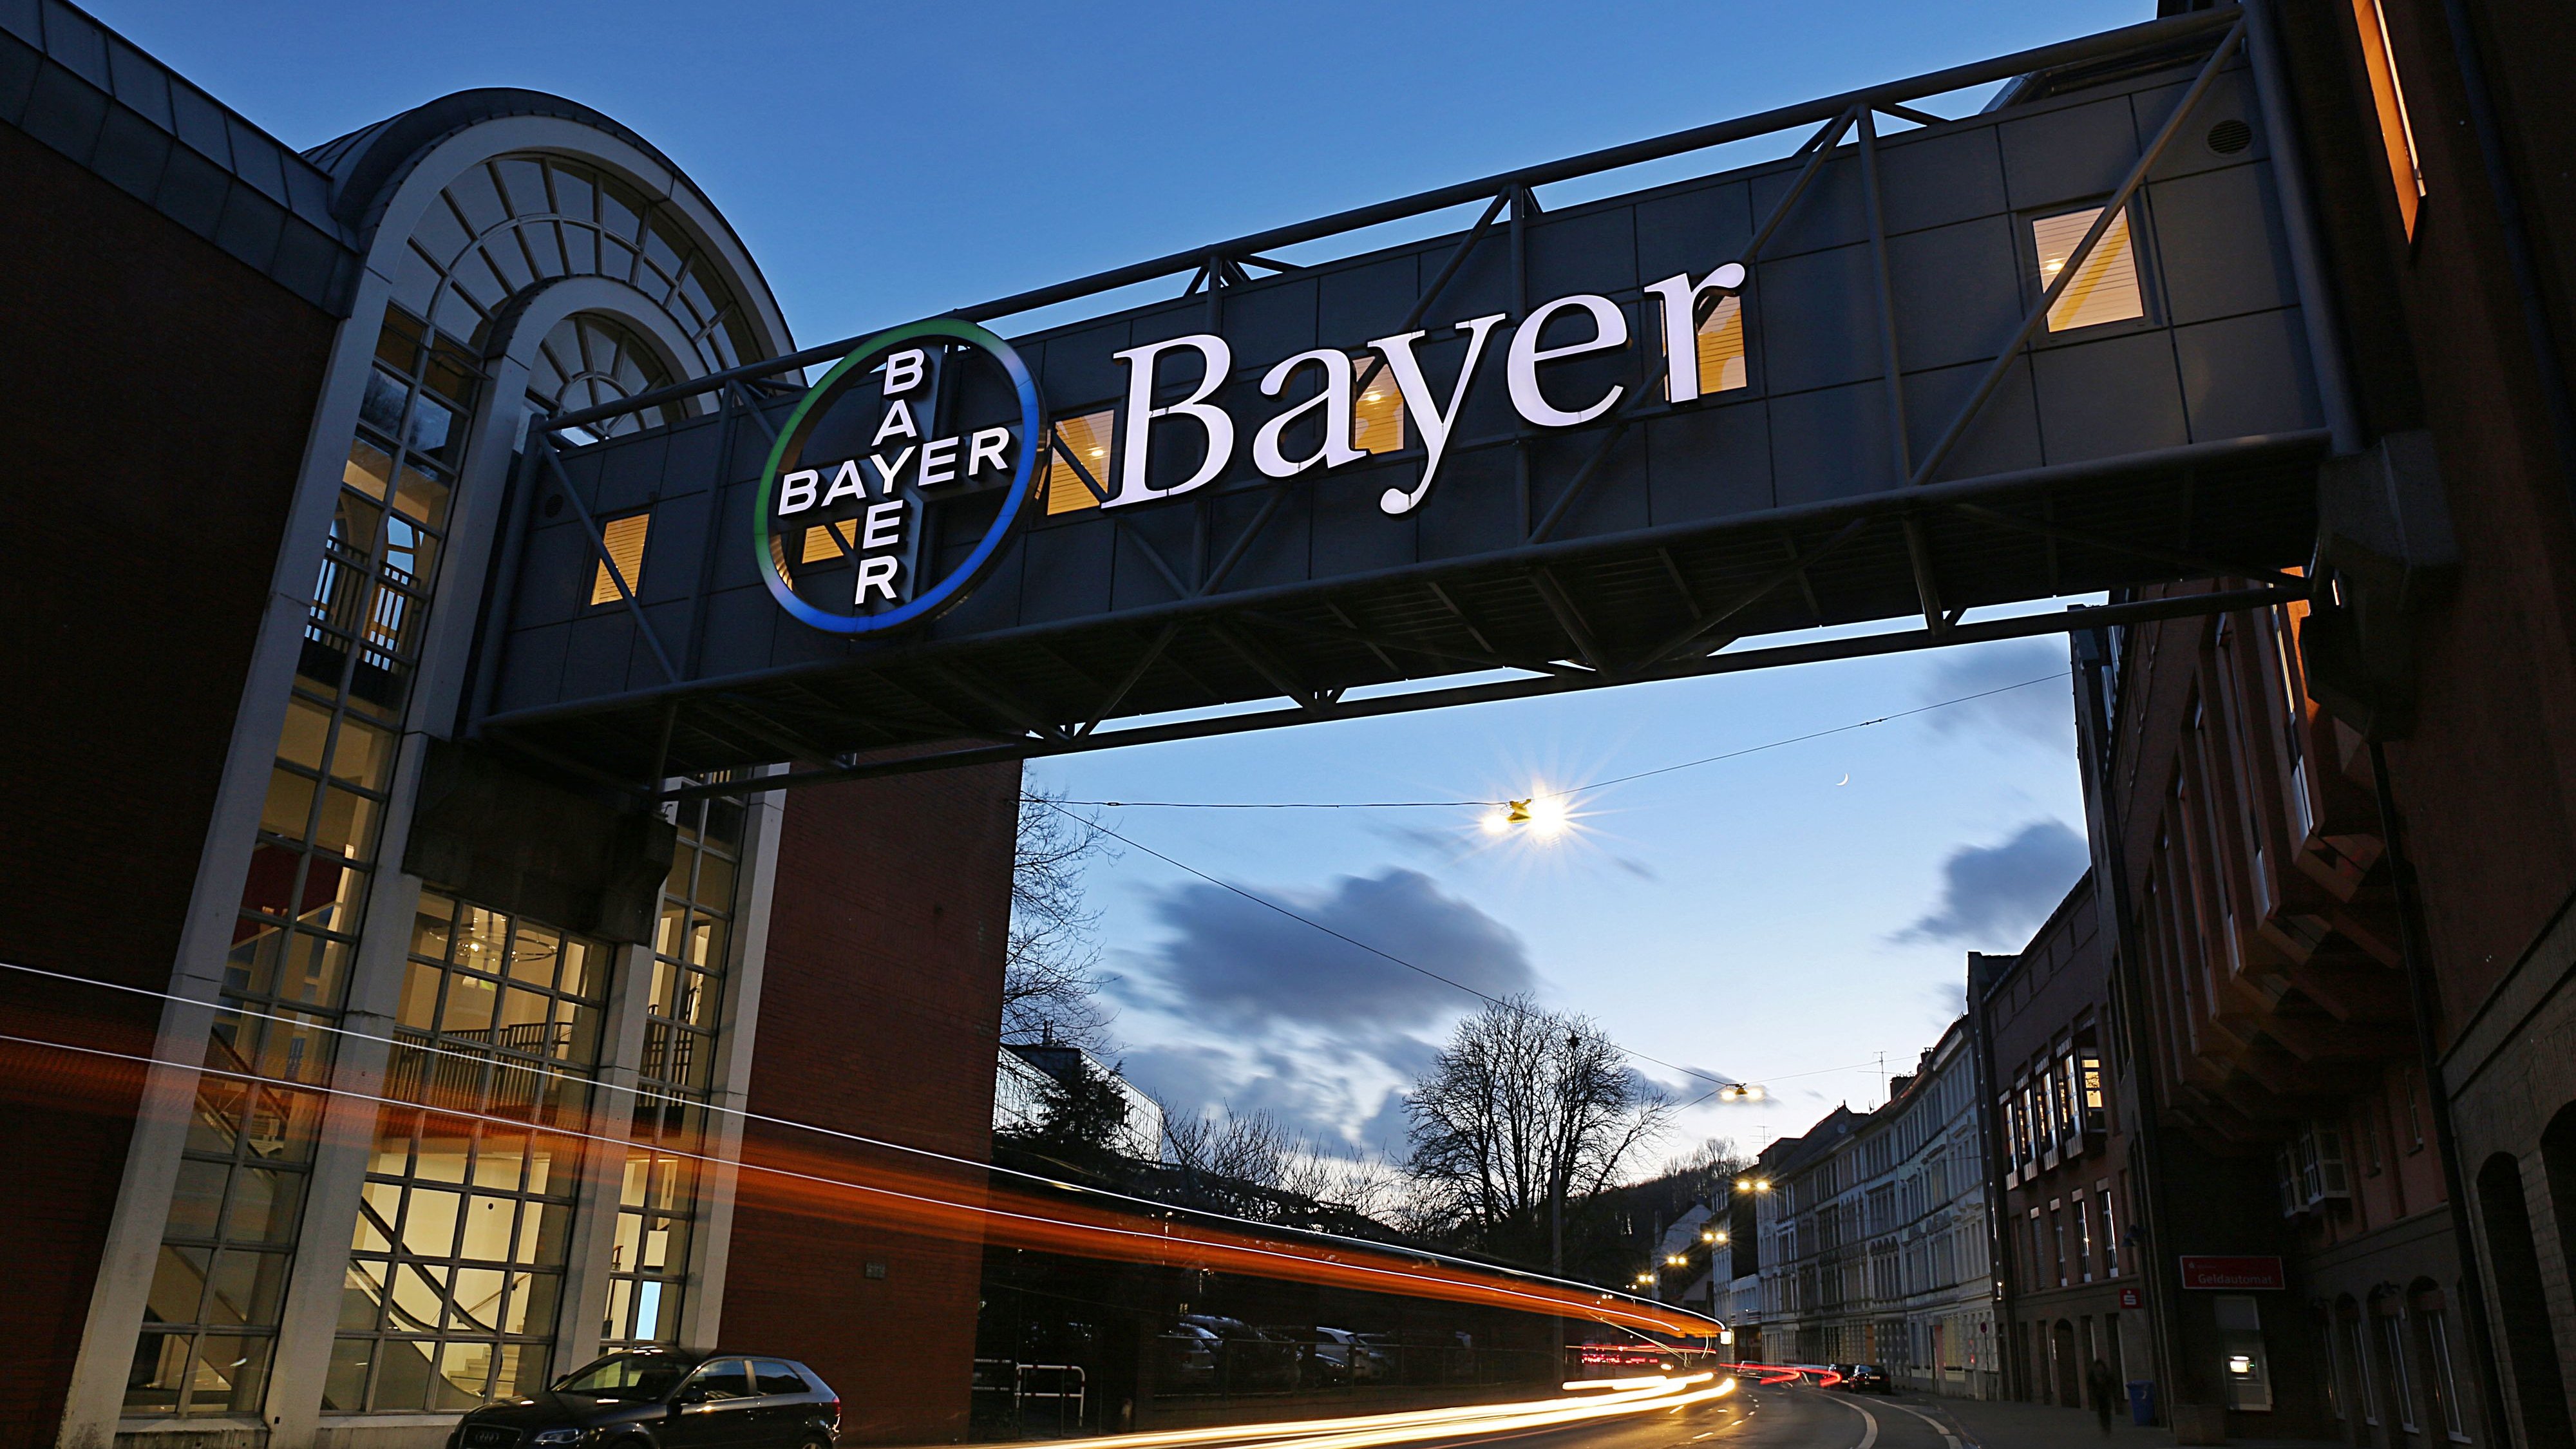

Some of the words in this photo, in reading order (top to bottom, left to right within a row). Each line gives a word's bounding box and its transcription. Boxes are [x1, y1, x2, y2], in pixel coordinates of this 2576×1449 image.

[777, 426, 1010, 516] BAYER
[1100, 262, 1746, 515] Bayer
[855, 348, 925, 605] BAYER
[2197, 1273, 2273, 1285] Geldautomat
